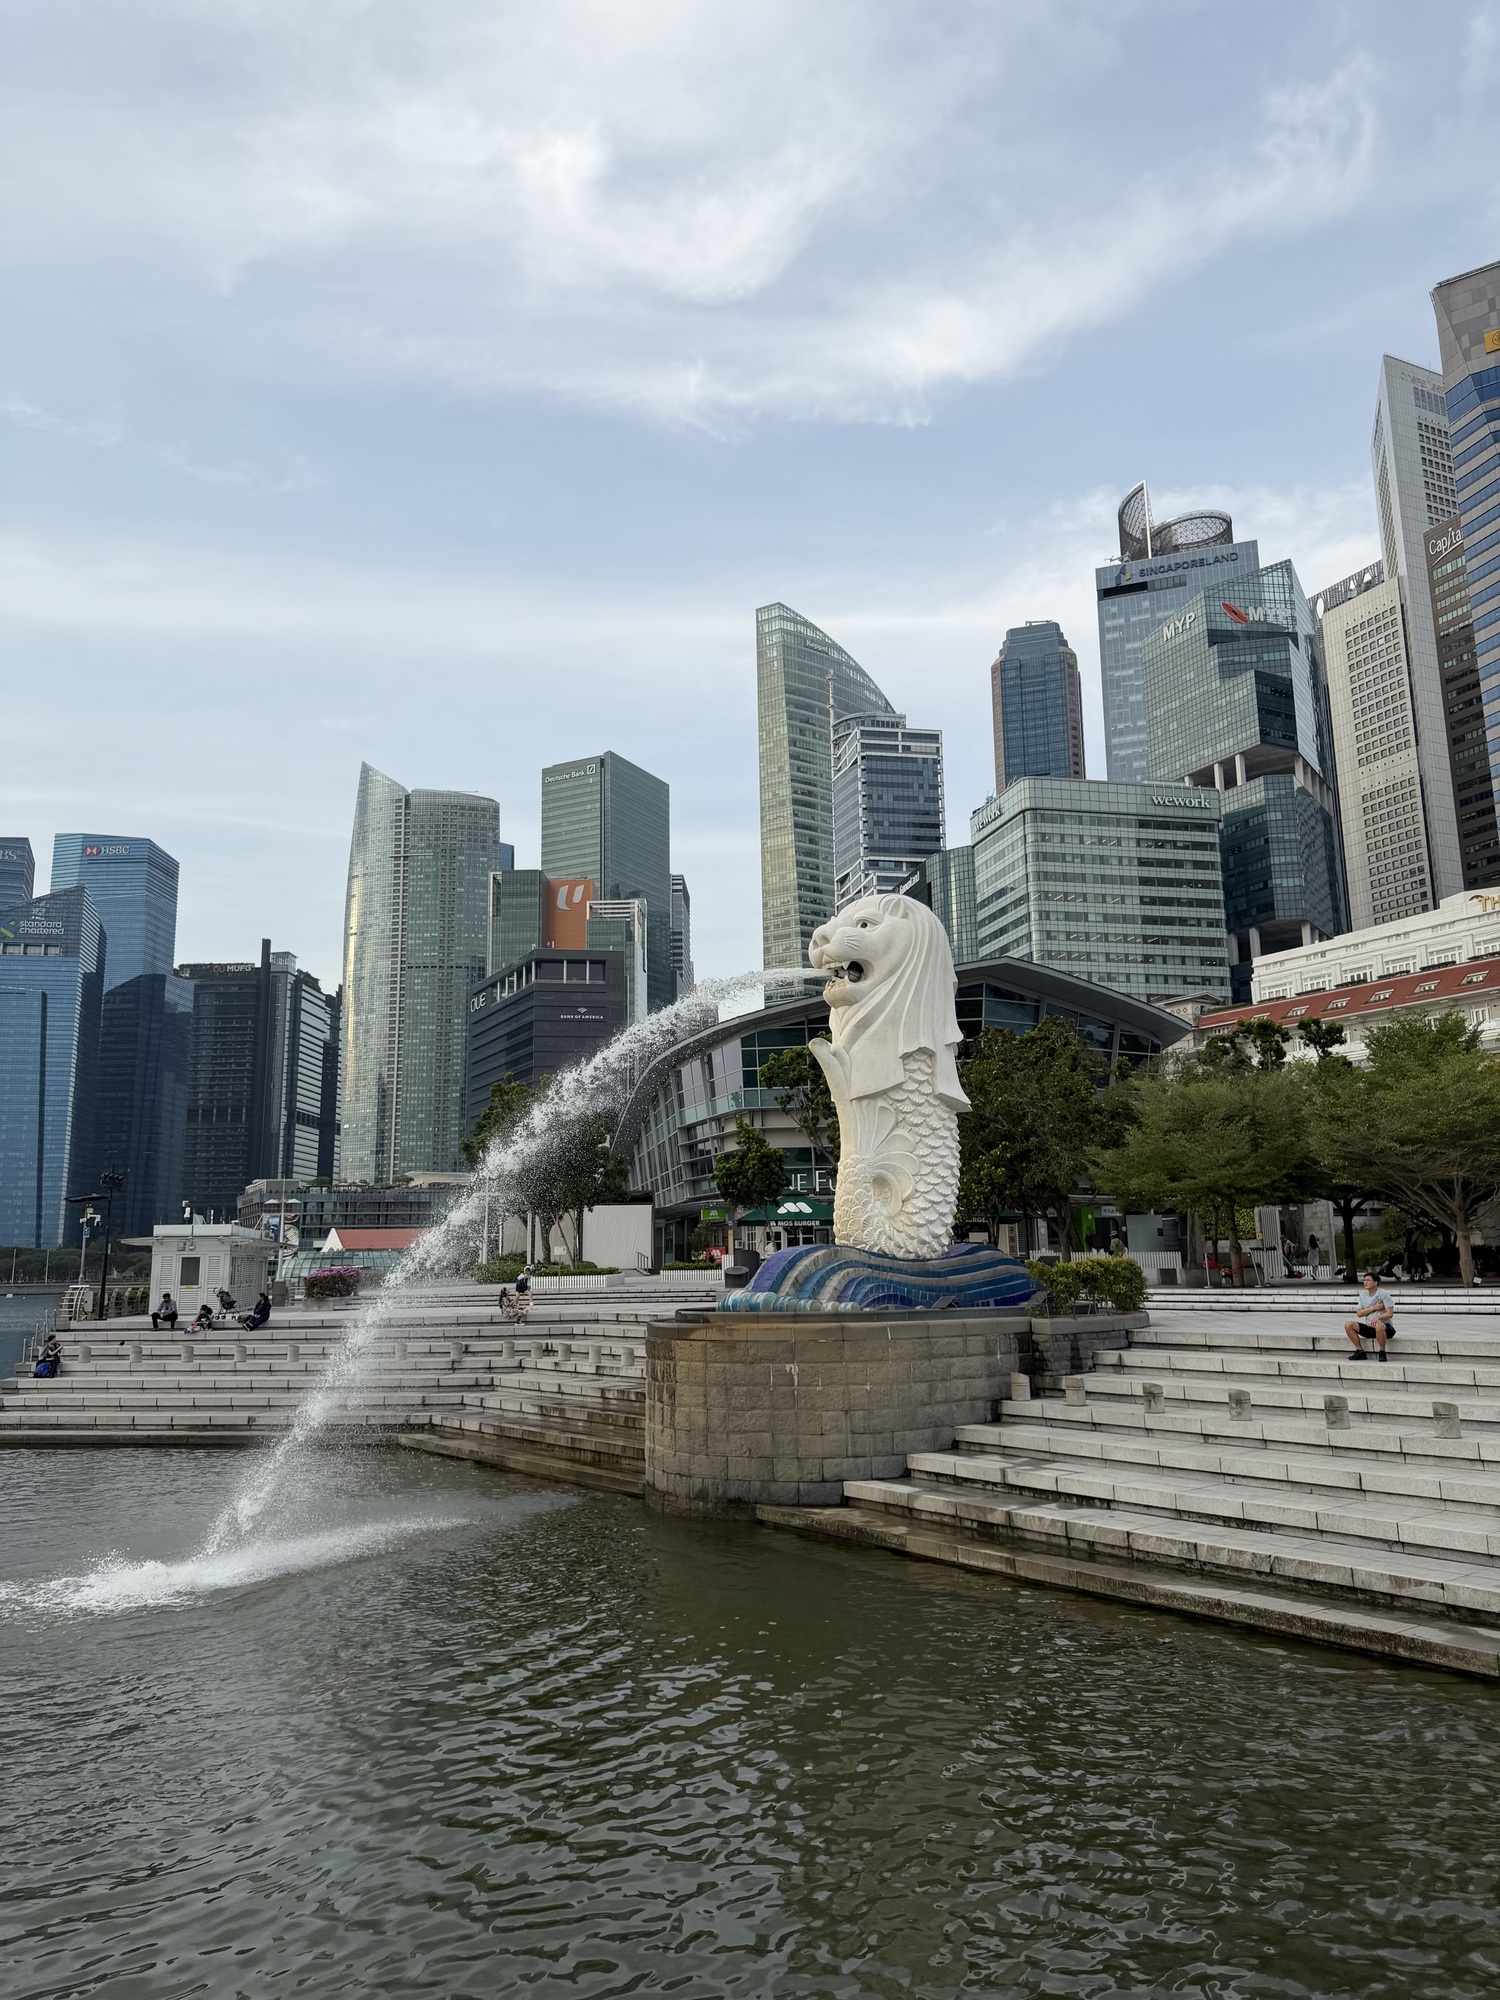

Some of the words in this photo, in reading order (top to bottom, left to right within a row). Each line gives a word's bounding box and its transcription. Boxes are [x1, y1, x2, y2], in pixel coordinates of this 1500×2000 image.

[1138, 552, 1239, 578] SINGAPORELAND
[1248, 606, 1291, 623] MYP
[1163, 612, 1196, 642] MYP
[806, 639, 829, 653] Keppel
[545, 773, 571, 784] Deutsche
[571, 769, 586, 778] Bank
[1151, 793, 1211, 808] wework
[101, 846, 130, 855] HSBC
[19, 927, 64, 935] chartered
[20, 920, 62, 928] standard
[226, 964, 252, 972] MUFG
[470, 992, 486, 1013] OUE
